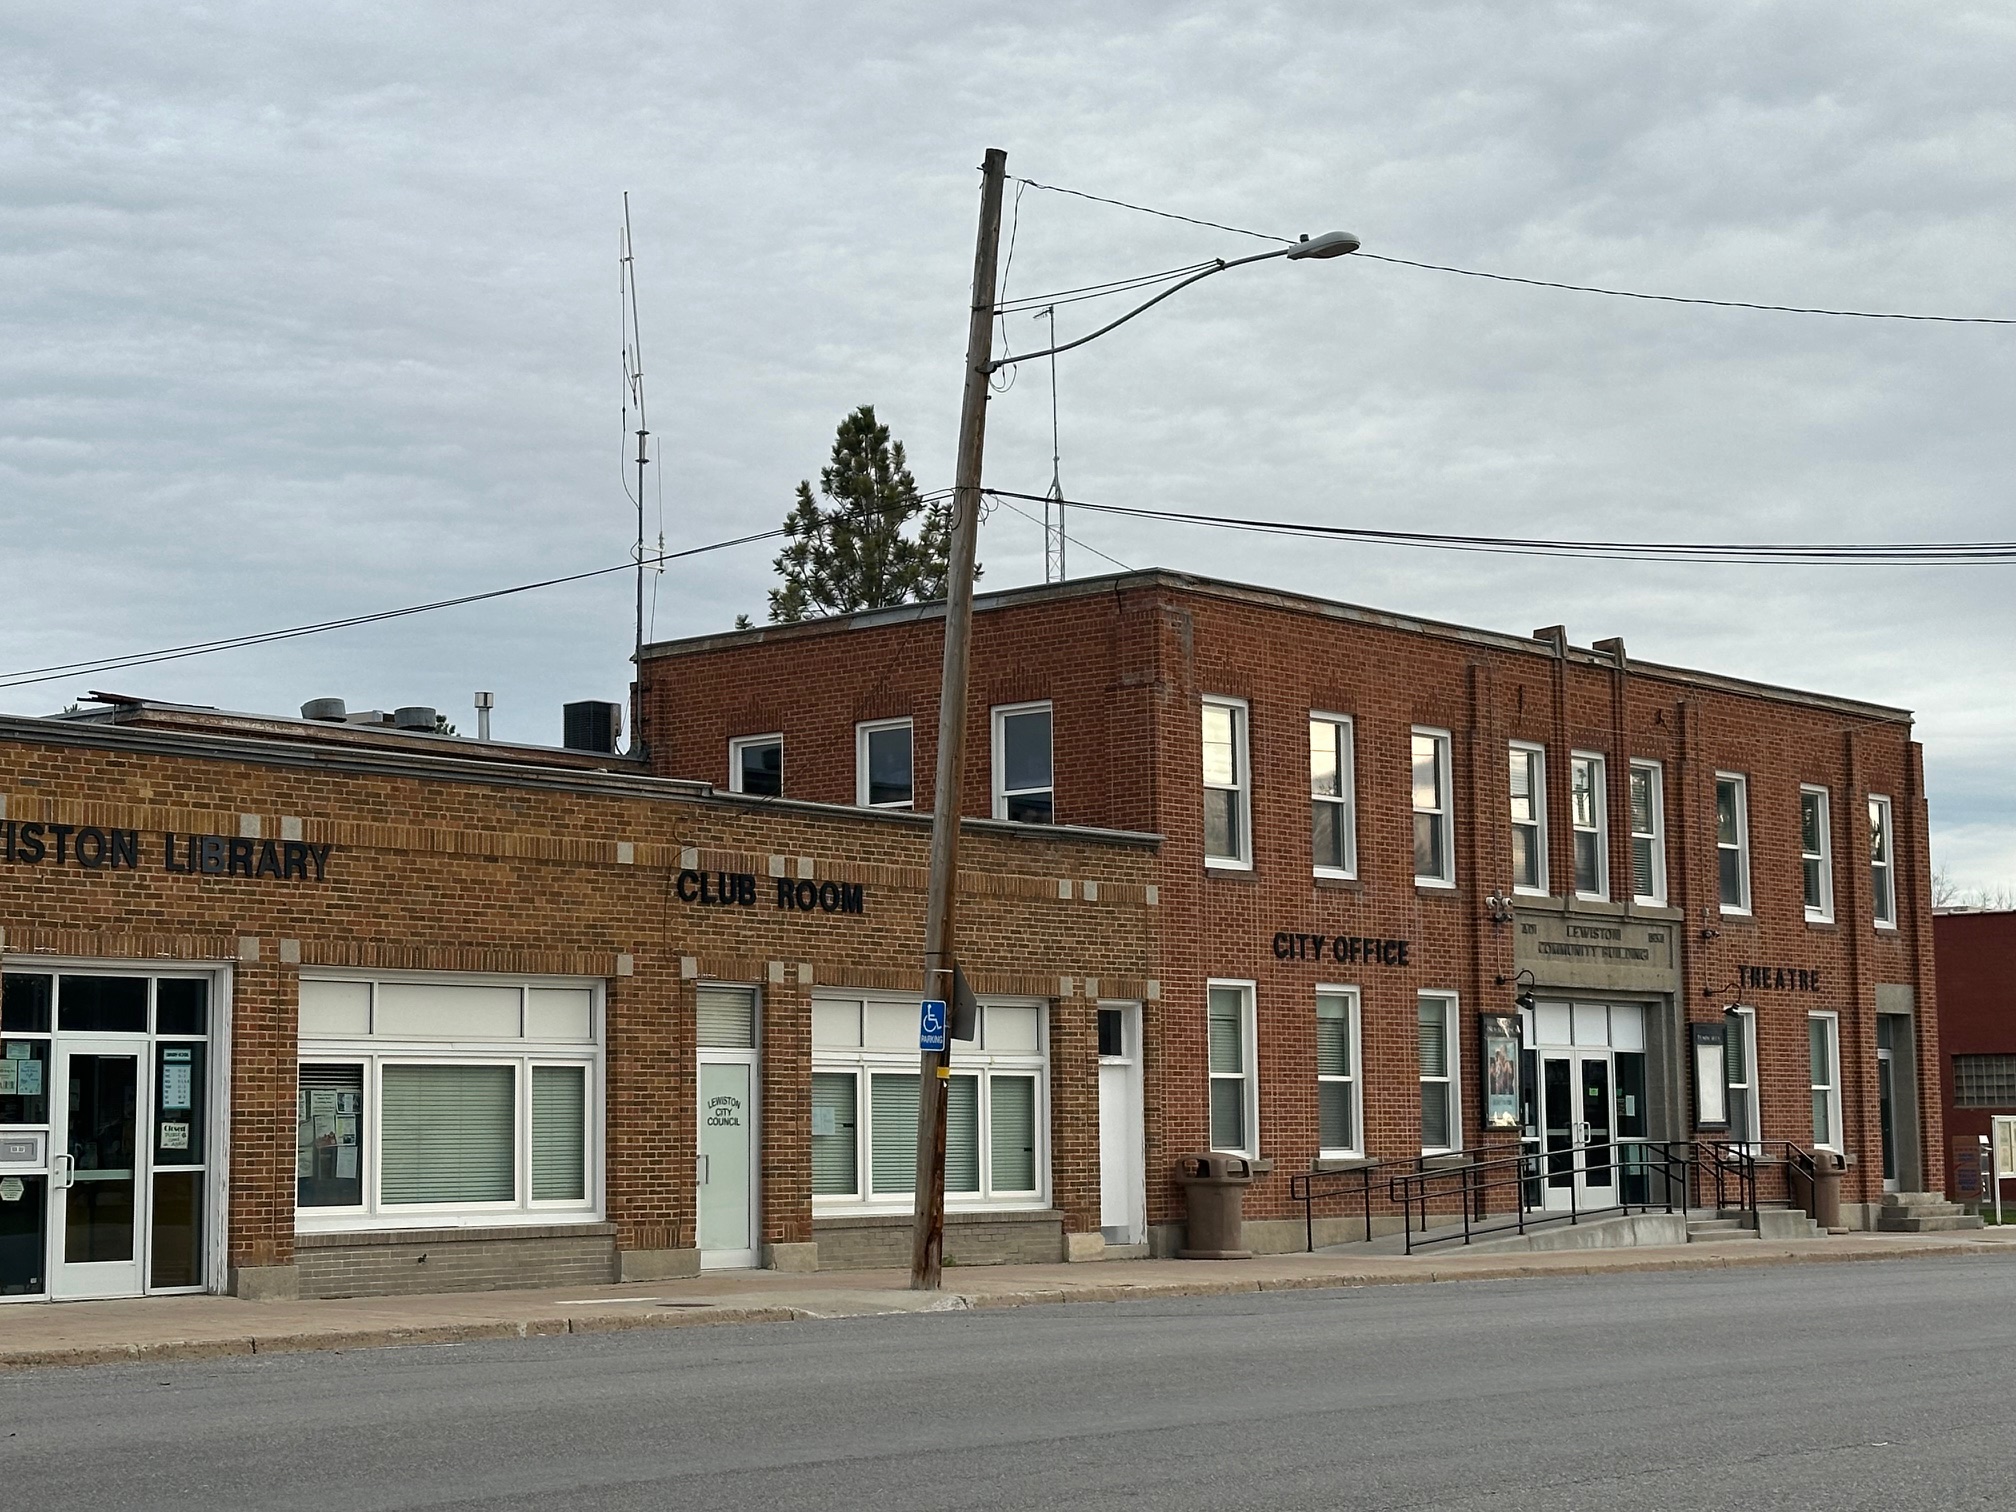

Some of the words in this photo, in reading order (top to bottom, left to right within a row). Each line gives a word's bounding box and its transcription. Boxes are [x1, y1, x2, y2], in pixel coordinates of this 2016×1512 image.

[0, 822, 138, 868] ISTON
[165, 832, 330, 880] LIBRARY
[677, 870, 756, 906] CLUB
[777, 878, 863, 914] ROOM
[1566, 925, 1621, 941] LEWISTON
[1273, 932, 1326, 961] CITY
[1333, 936, 1410, 966] OFFICE
[1538, 942, 1597, 957] COMMUNITY
[1737, 964, 1820, 992] THEATRE
[920, 1034, 943, 1044] PARKING
[707, 1096, 741, 1109] LEWISTON
[715, 1108, 732, 1117] CITY
[707, 1116, 741, 1126] COUNCIL
